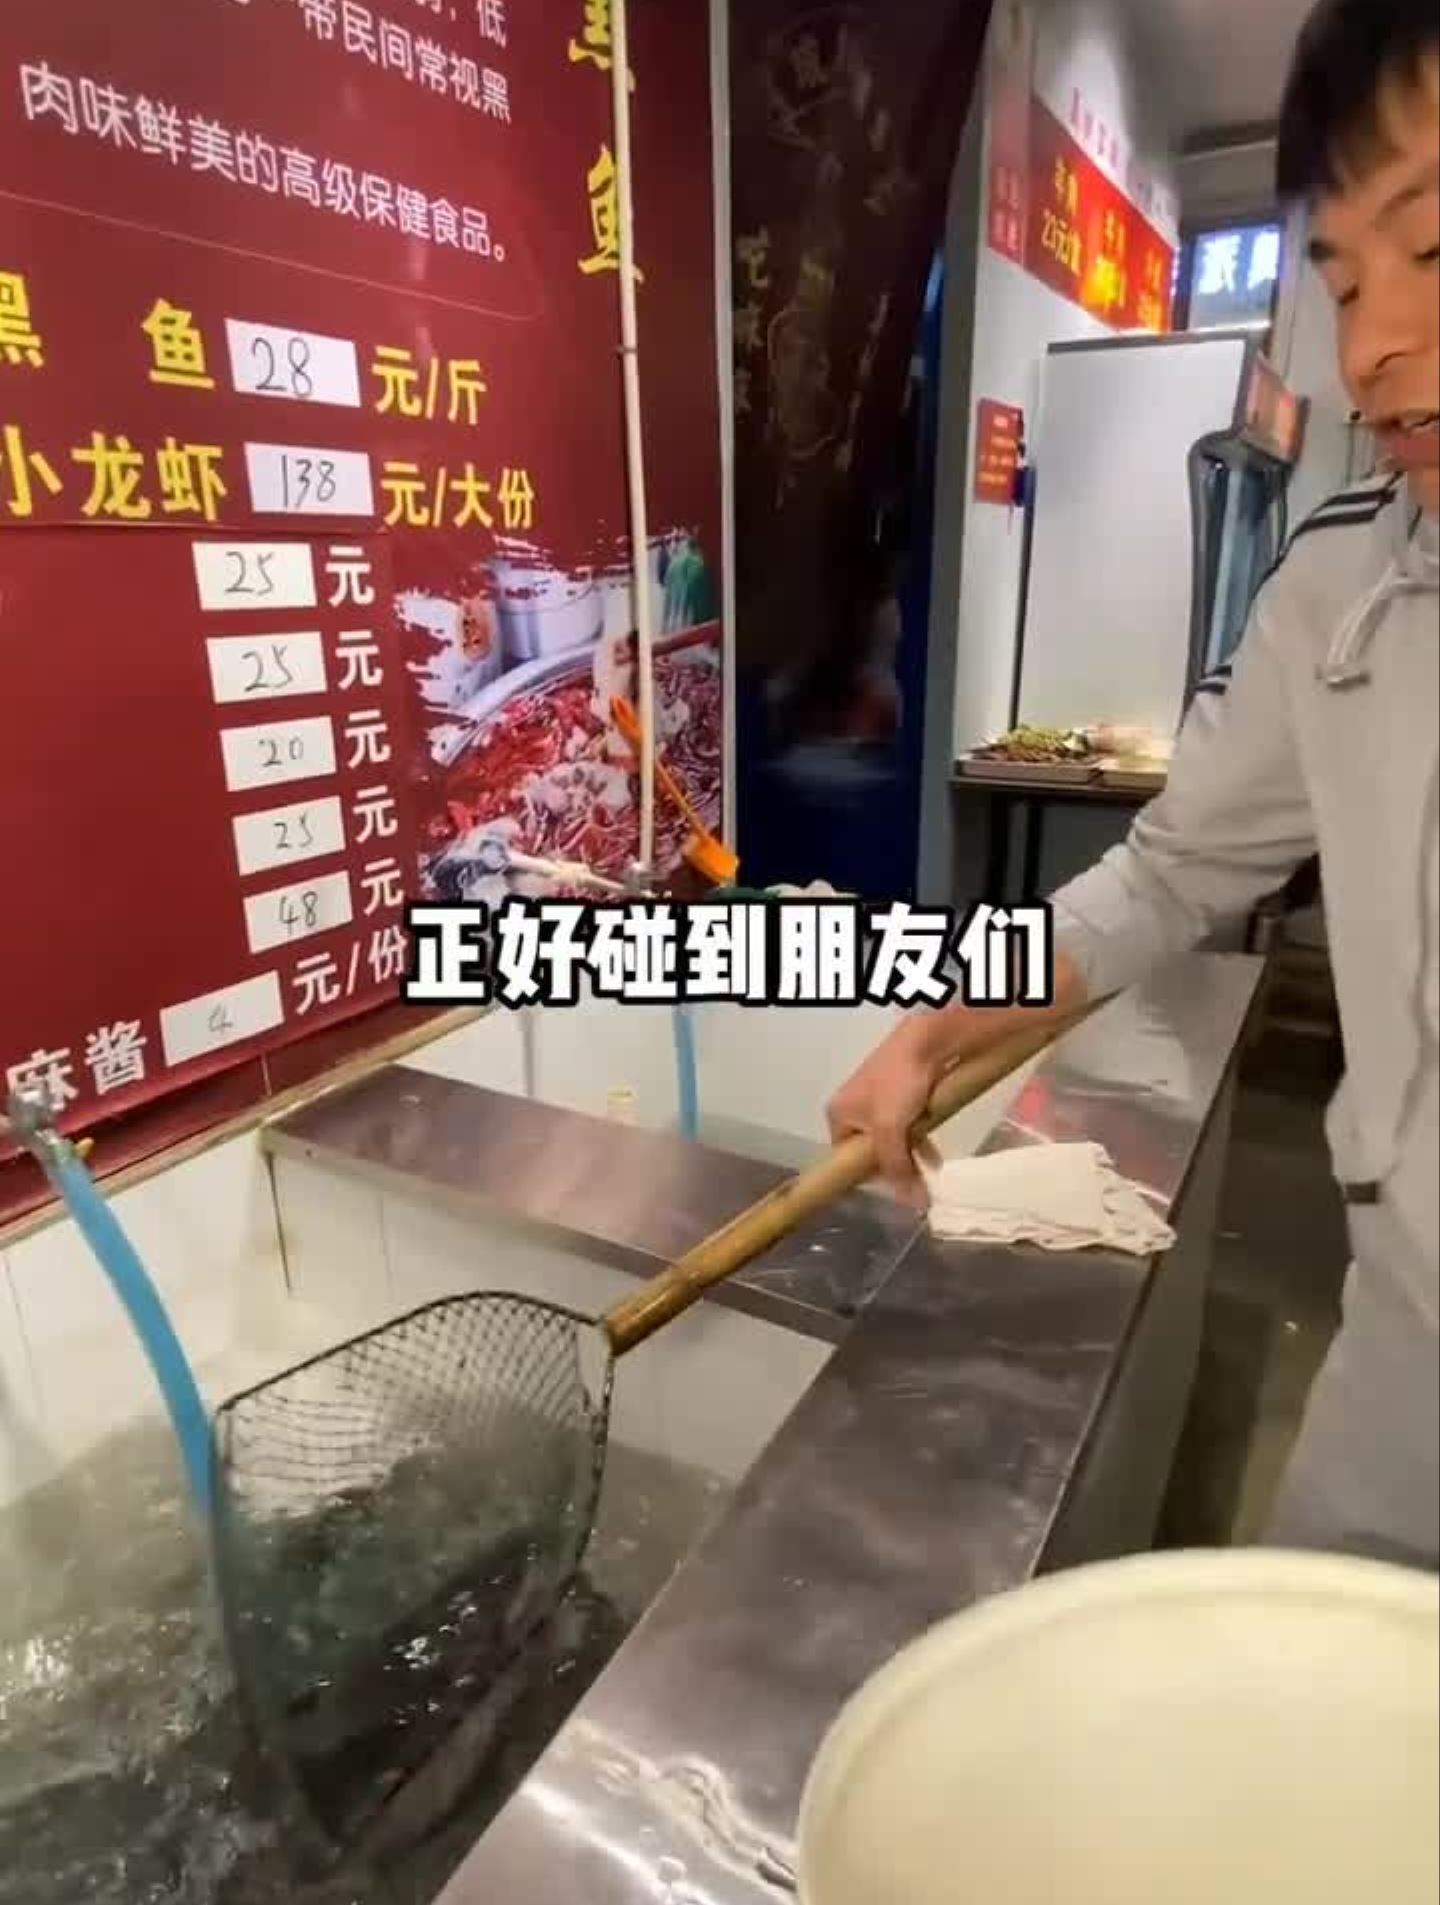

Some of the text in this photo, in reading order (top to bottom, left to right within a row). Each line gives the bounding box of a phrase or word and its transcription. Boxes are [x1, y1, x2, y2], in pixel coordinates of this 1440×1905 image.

[19, 61, 506, 263] 肉味鲜美的高级保健食品。
[141, 298, 215, 390] 鱼
[251, 336, 314, 399] 28
[371, 345, 487, 426] 元/斤
[280, 454, 338, 510] 138
[380, 462, 536, 529] 元/大份
[224, 546, 375, 607] 25 元
[242, 630, 384, 693] 25 元
[258, 709, 391, 769] 20 元
[272, 784, 398, 850] 25 元
[277, 856, 404, 935] 48 元
[292, 925, 405, 1015] 元/份
